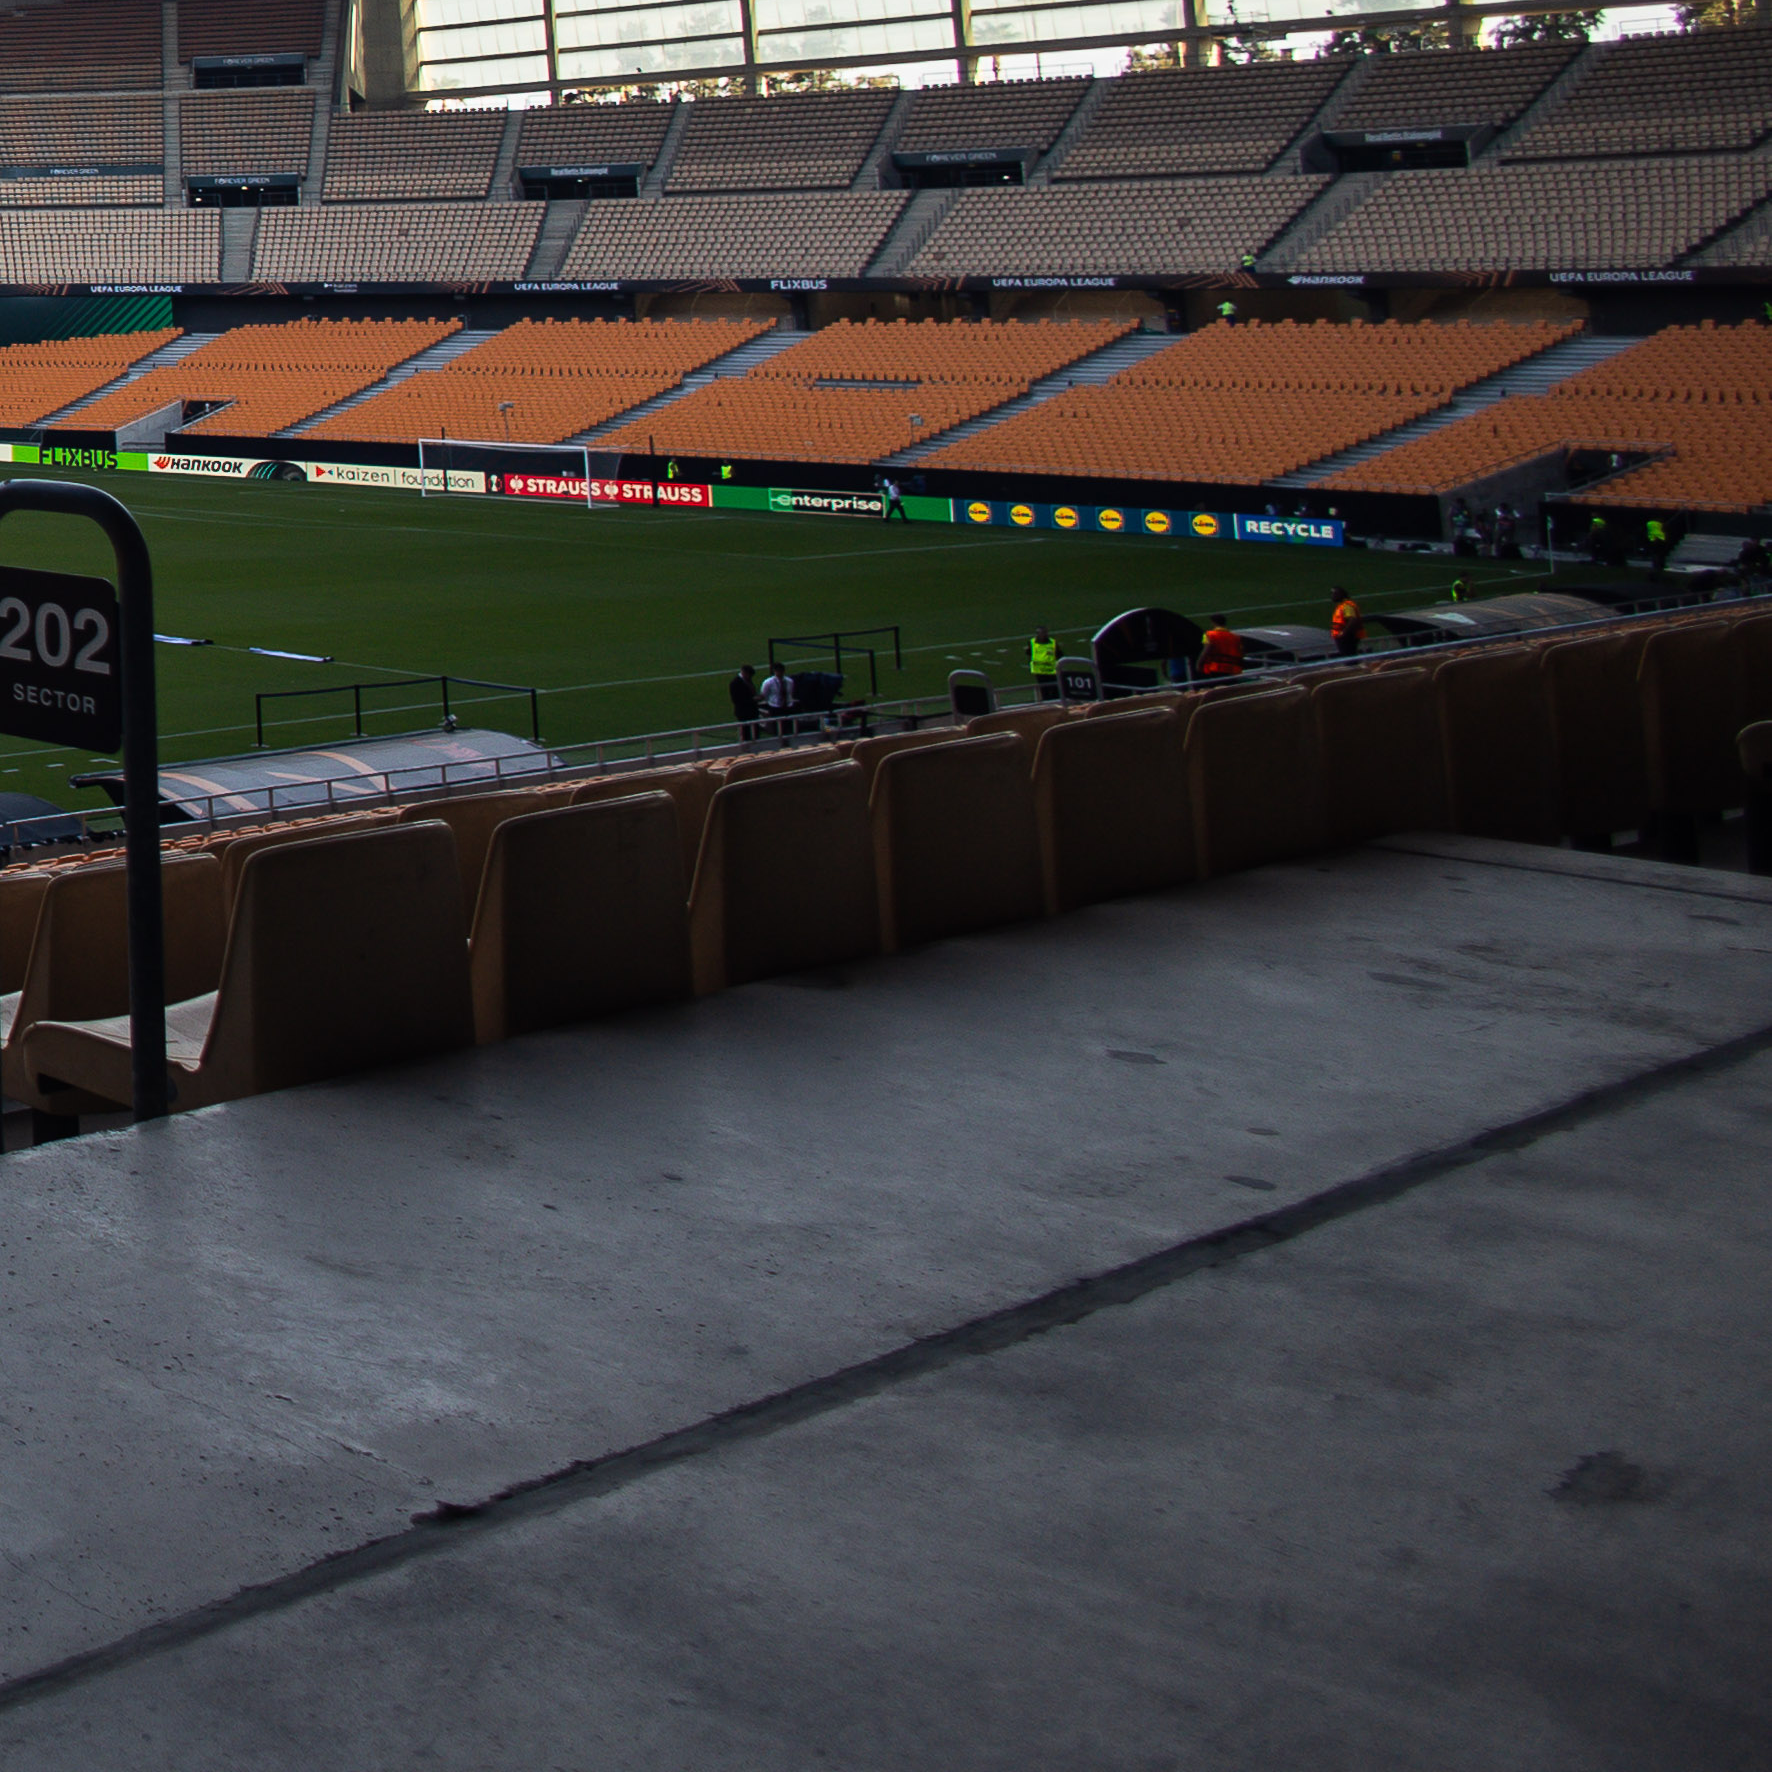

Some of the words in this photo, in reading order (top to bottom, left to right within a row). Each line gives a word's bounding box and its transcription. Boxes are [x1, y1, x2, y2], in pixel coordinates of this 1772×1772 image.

[992, 278, 1022, 287] UEFA
[1024, 278, 1068, 287] EUROPA
[1070, 277, 1114, 286] LEAGUE
[1549, 273, 1584, 283] UEFA
[1587, 271, 1639, 282] EUROPA
[1641, 270, 1693, 282] LEAGUE
[90, 285, 113, 293] UEFA
[148, 285, 182, 293] LEAGUE
[514, 283, 539, 291] UEFA
[541, 283, 579, 291] EUROPA
[581, 282, 618, 291] LEAGUE
[337, 466, 390, 483] kaizen
[526, 477, 601, 496] STRAUSS
[622, 483, 703, 503] STRAUSS
[771, 494, 882, 511] enterprise
[1245, 518, 1334, 540] RECYCLE
[1067, 676, 1092, 690] 101
[12, 682, 97, 716] SECTOR
